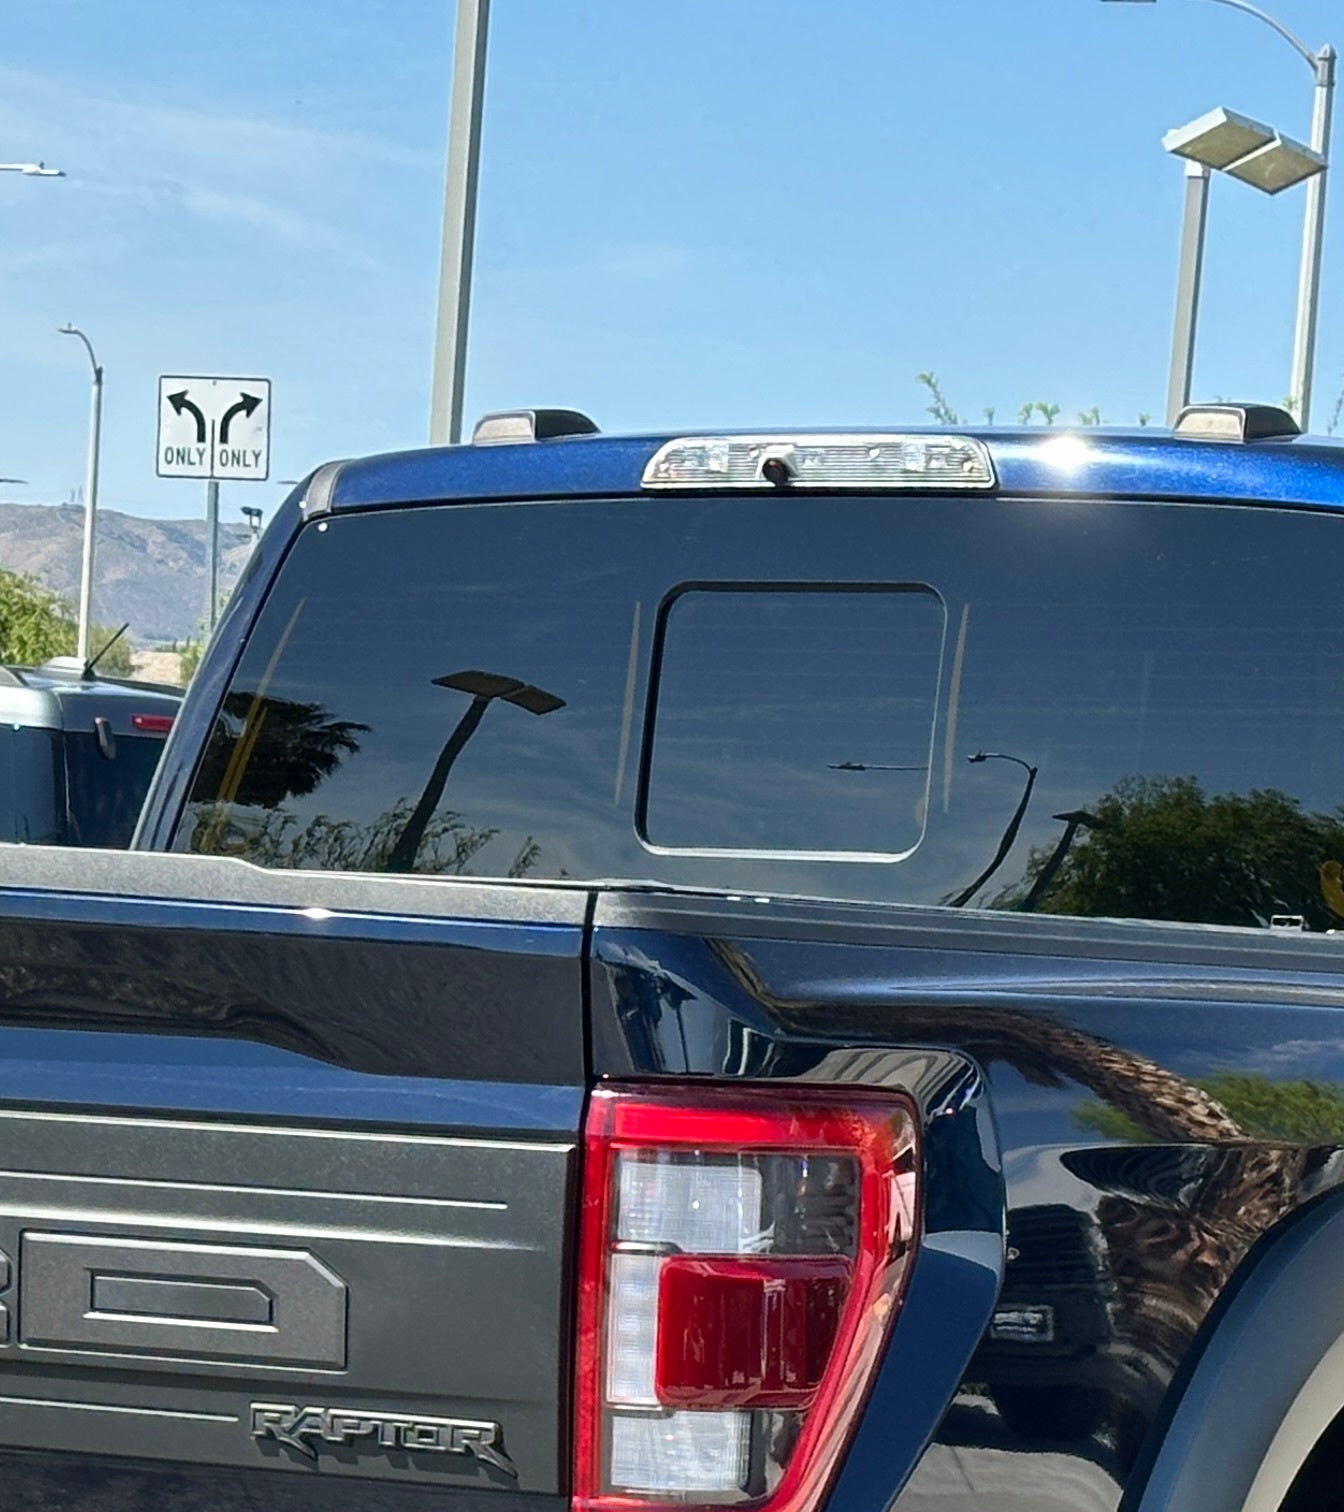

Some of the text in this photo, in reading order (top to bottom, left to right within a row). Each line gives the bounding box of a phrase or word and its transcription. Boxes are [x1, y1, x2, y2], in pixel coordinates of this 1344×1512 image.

[164, 446, 207, 467] ONLY
[219, 449, 262, 468] ONLY
[250, 1402, 519, 1480] RAPTOR
